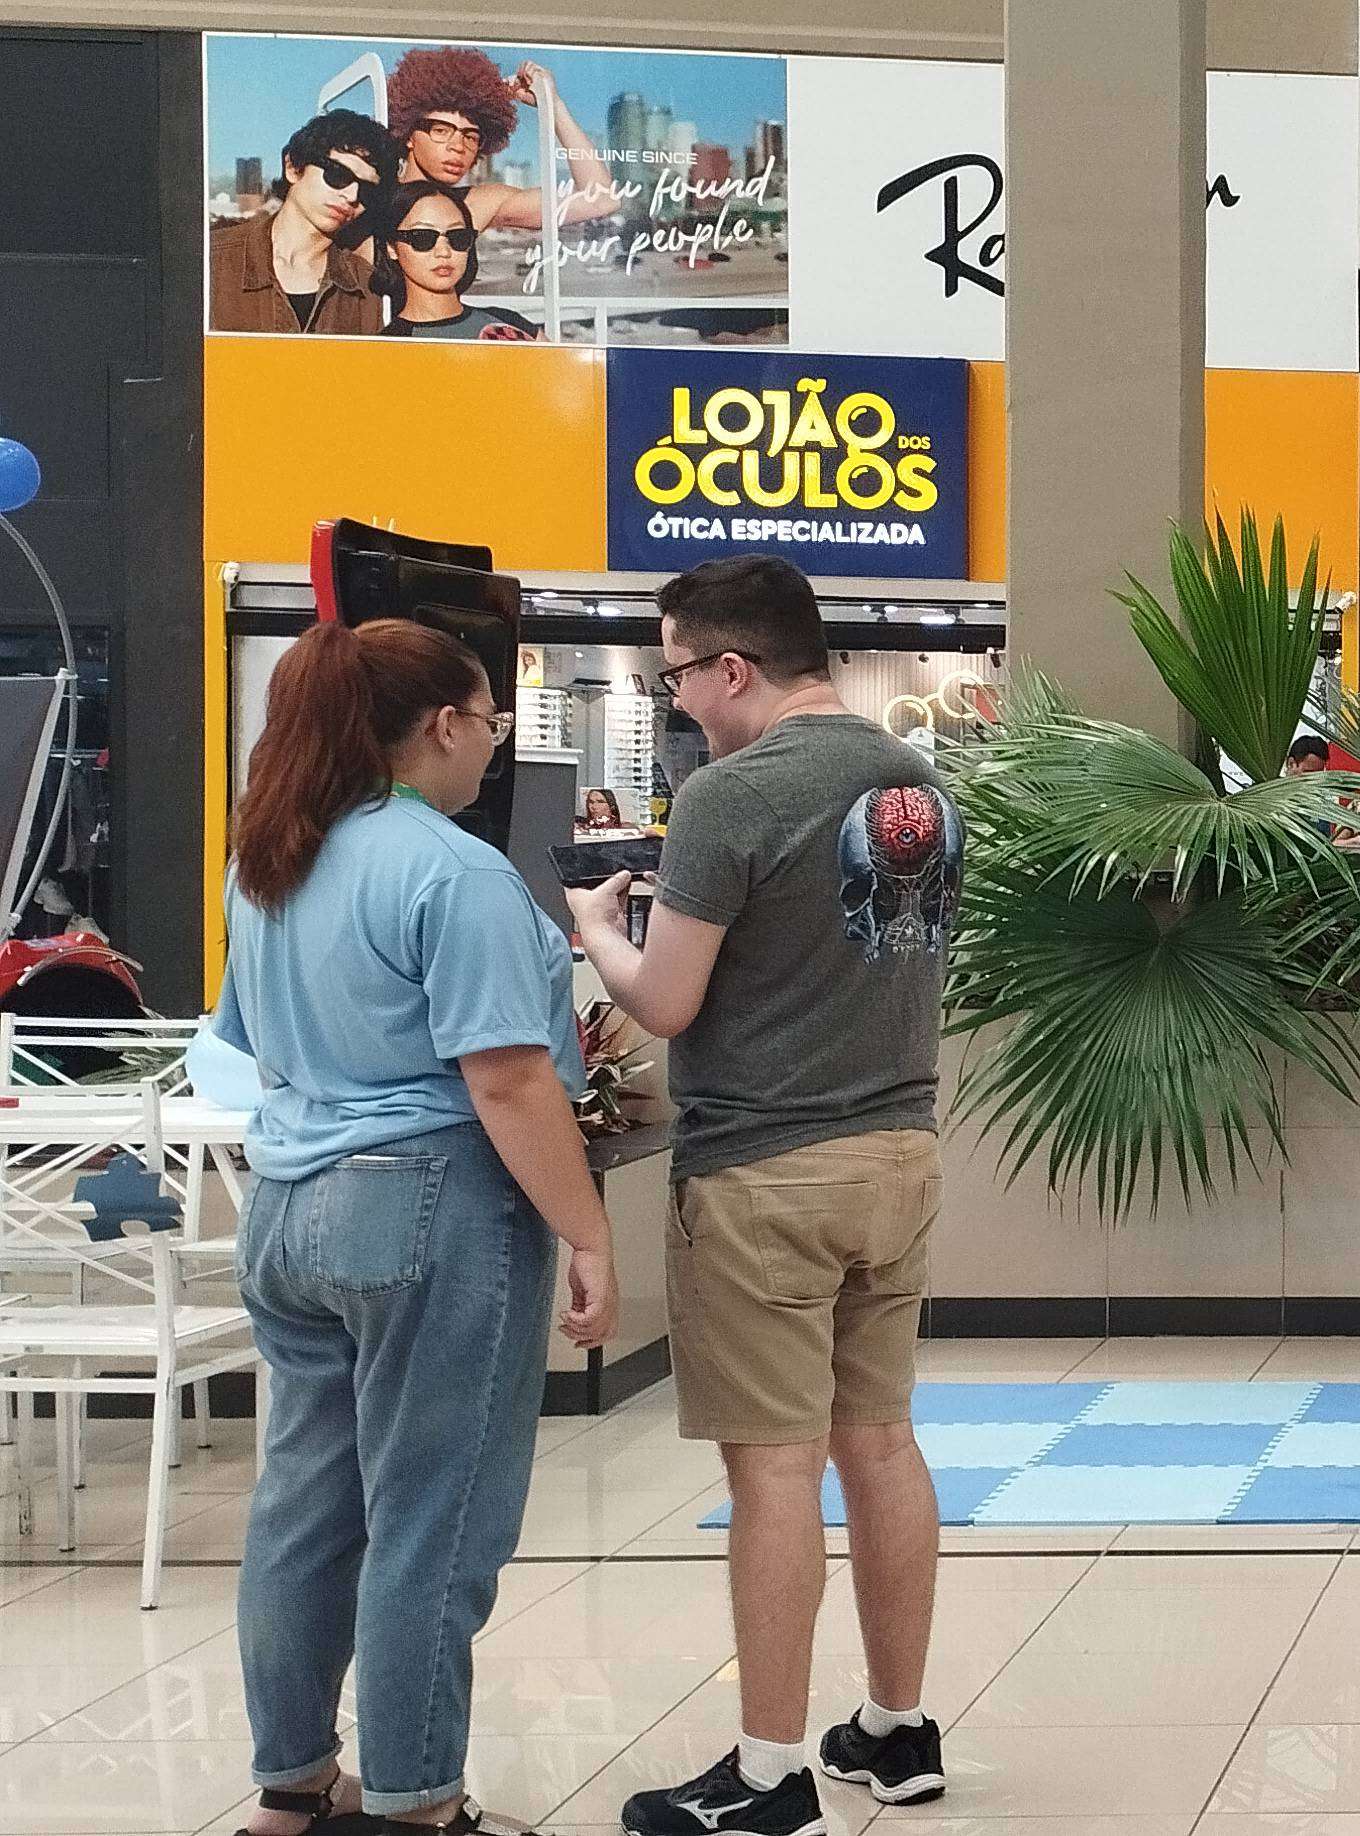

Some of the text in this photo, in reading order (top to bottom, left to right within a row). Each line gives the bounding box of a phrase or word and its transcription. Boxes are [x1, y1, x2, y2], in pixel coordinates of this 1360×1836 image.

[556, 148, 698, 165] GENUINE SINCE
[556, 155, 775, 224] you found
[522, 203, 753, 294] your people
[673, 378, 896, 457] LOJÃO
[898, 435, 931, 450] DOS
[634, 436, 938, 512] ÓCULOS
[647, 511, 927, 545] ÓTICA ESPECIALIZADA
